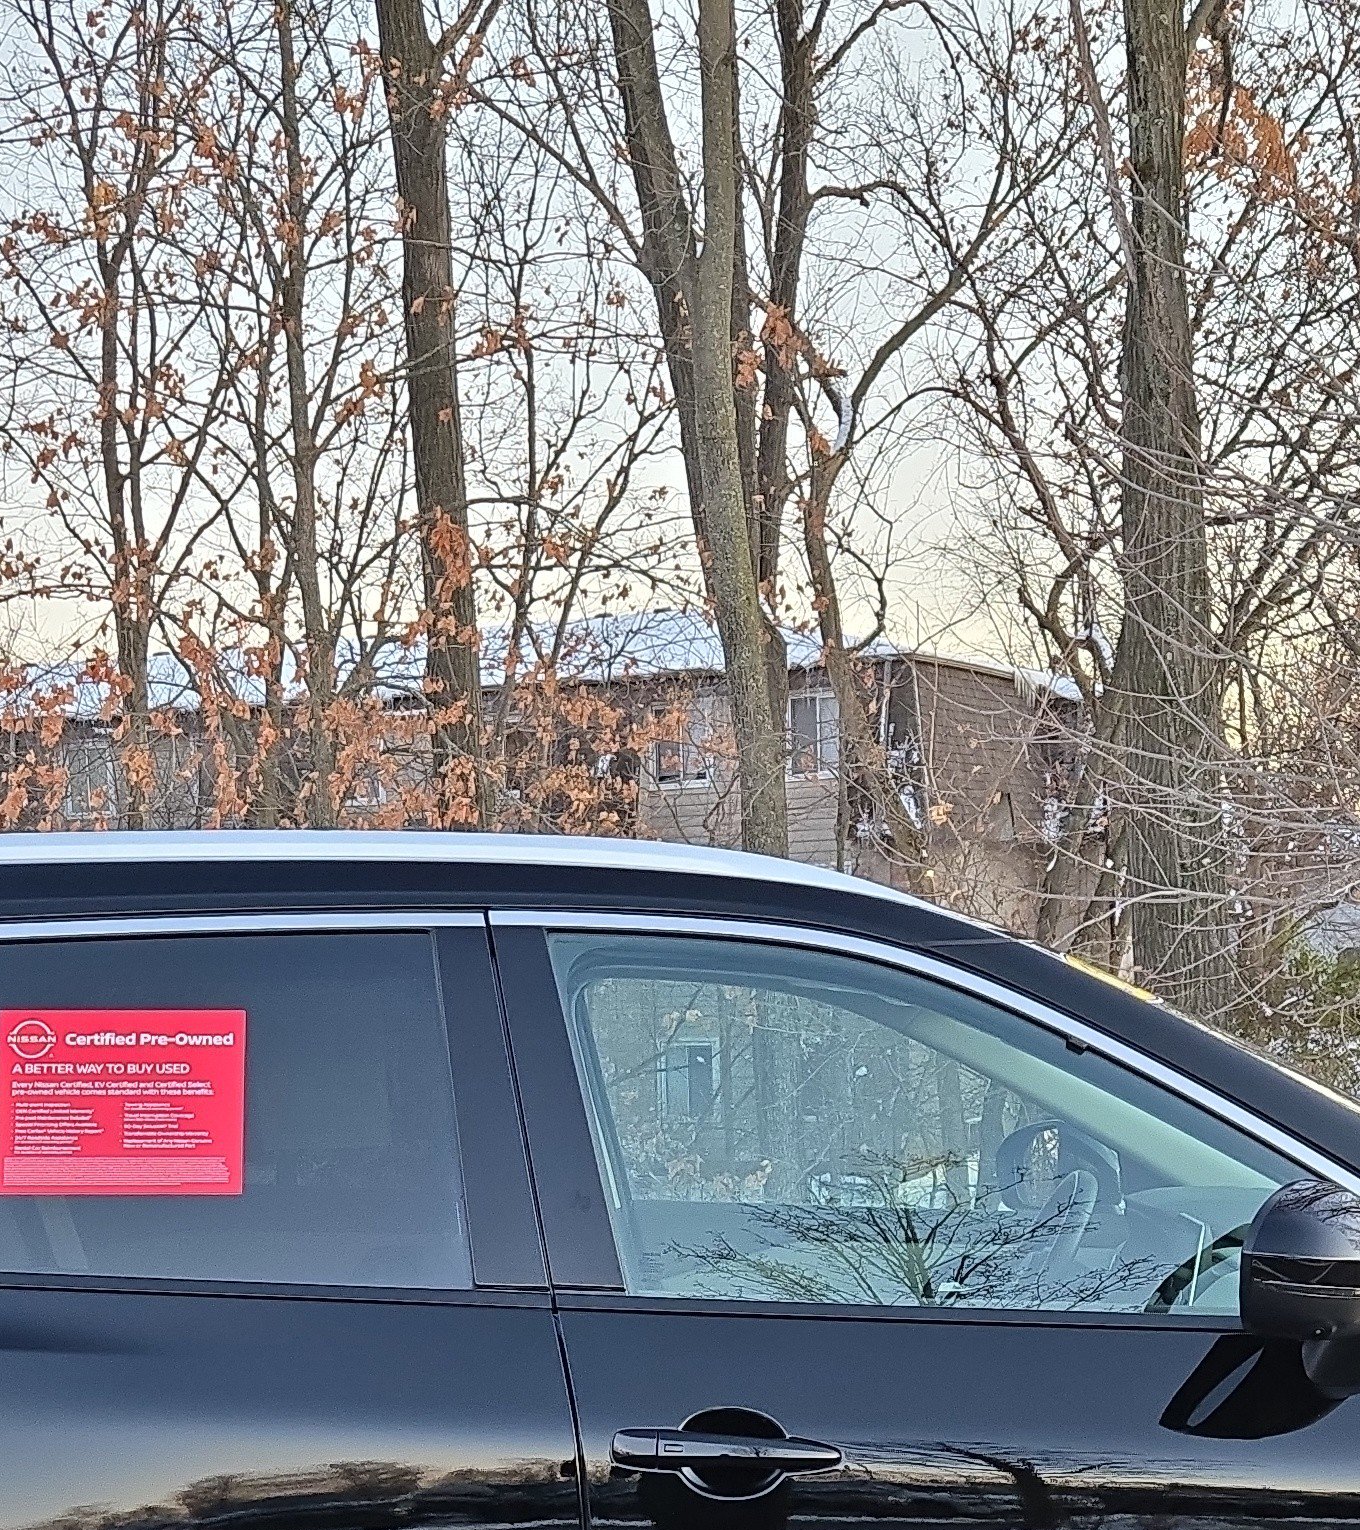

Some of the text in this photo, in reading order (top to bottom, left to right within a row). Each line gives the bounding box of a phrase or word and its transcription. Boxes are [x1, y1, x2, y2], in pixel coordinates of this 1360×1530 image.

[6, 1034, 57, 1044] NISSAN
[65, 1032, 234, 1046] Certified Pre-Owned
[11, 1063, 190, 1075] A BETTER WAY TO BUY USED
[11, 1081, 34, 1090] Every
[34, 1081, 59, 1090] Nissan
[106, 1081, 138, 1090] Certified
[139, 1081, 154, 1090] and
[155, 1081, 186, 1090] Certified
[11, 1088, 53, 1097] pre-owned
[54, 1088, 80, 1097] vehicle
[81, 1088, 106, 1097] comes
[107, 1088, 141, 1097] standard
